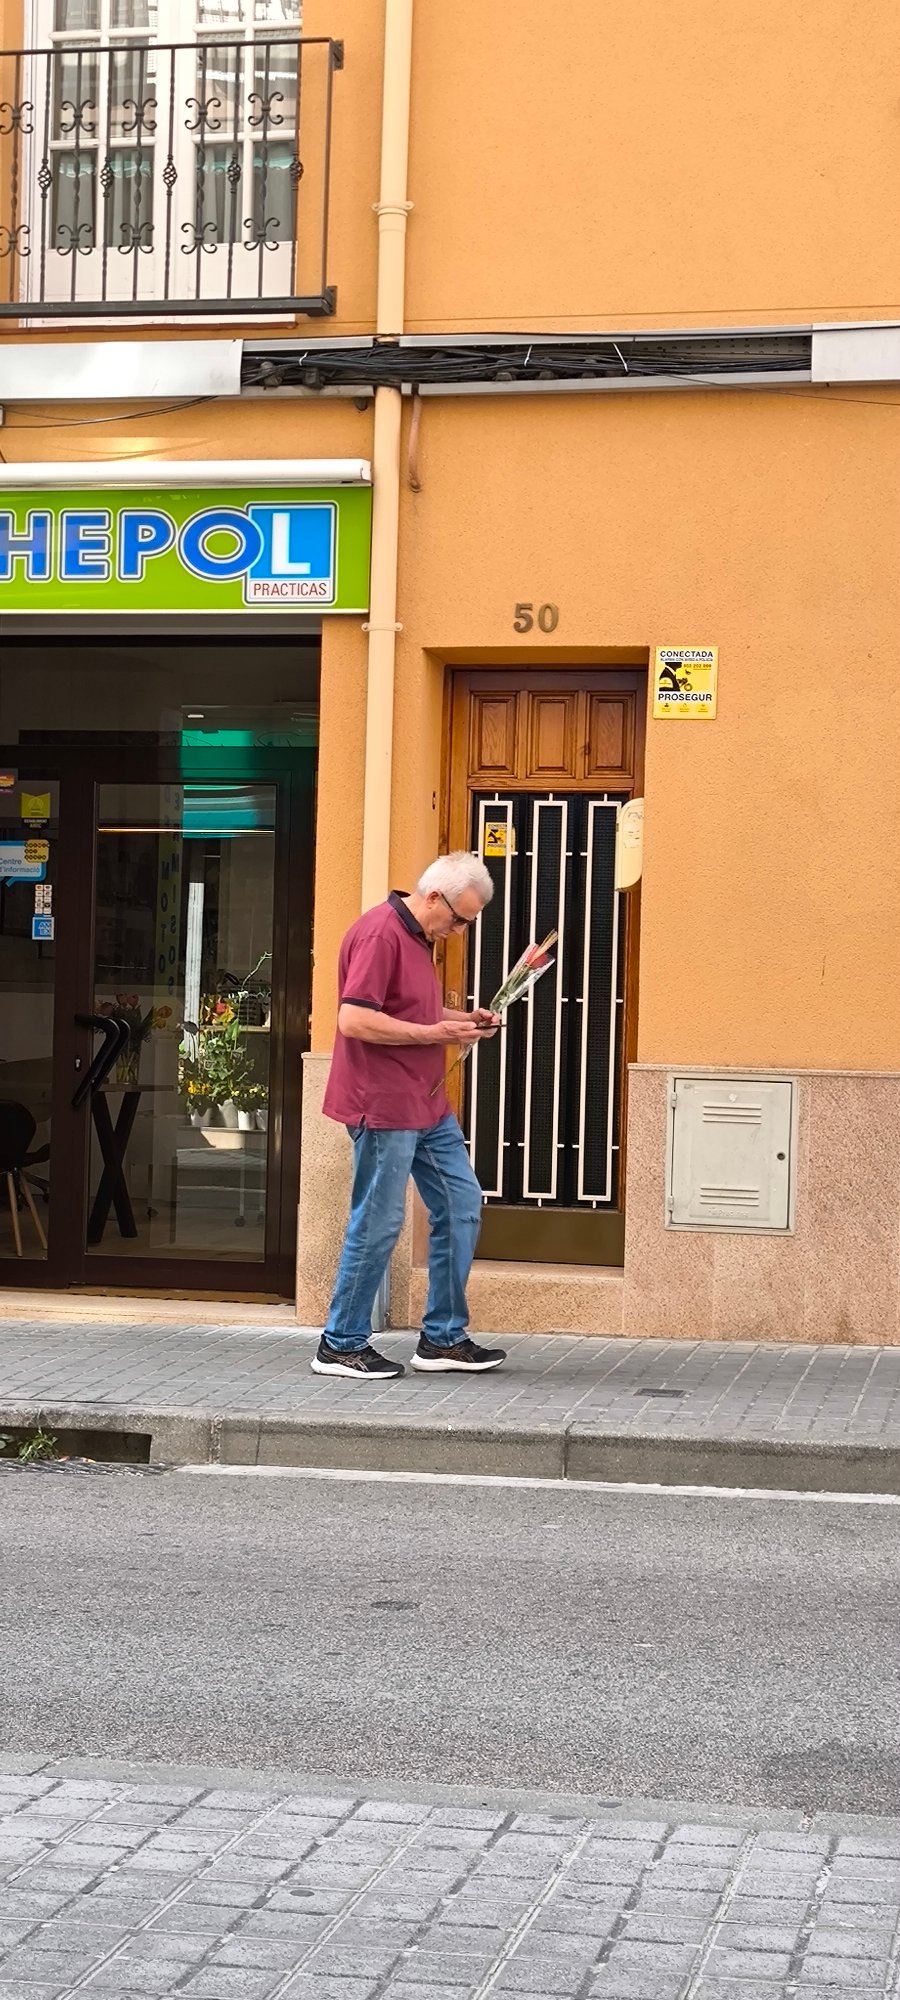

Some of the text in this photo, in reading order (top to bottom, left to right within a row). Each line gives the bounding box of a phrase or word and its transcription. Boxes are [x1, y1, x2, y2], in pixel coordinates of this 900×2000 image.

[253, 582, 327, 597] PRACTICAS
[513, 603, 559, 633] 50
[658, 693, 712, 701] PROSEGUR
